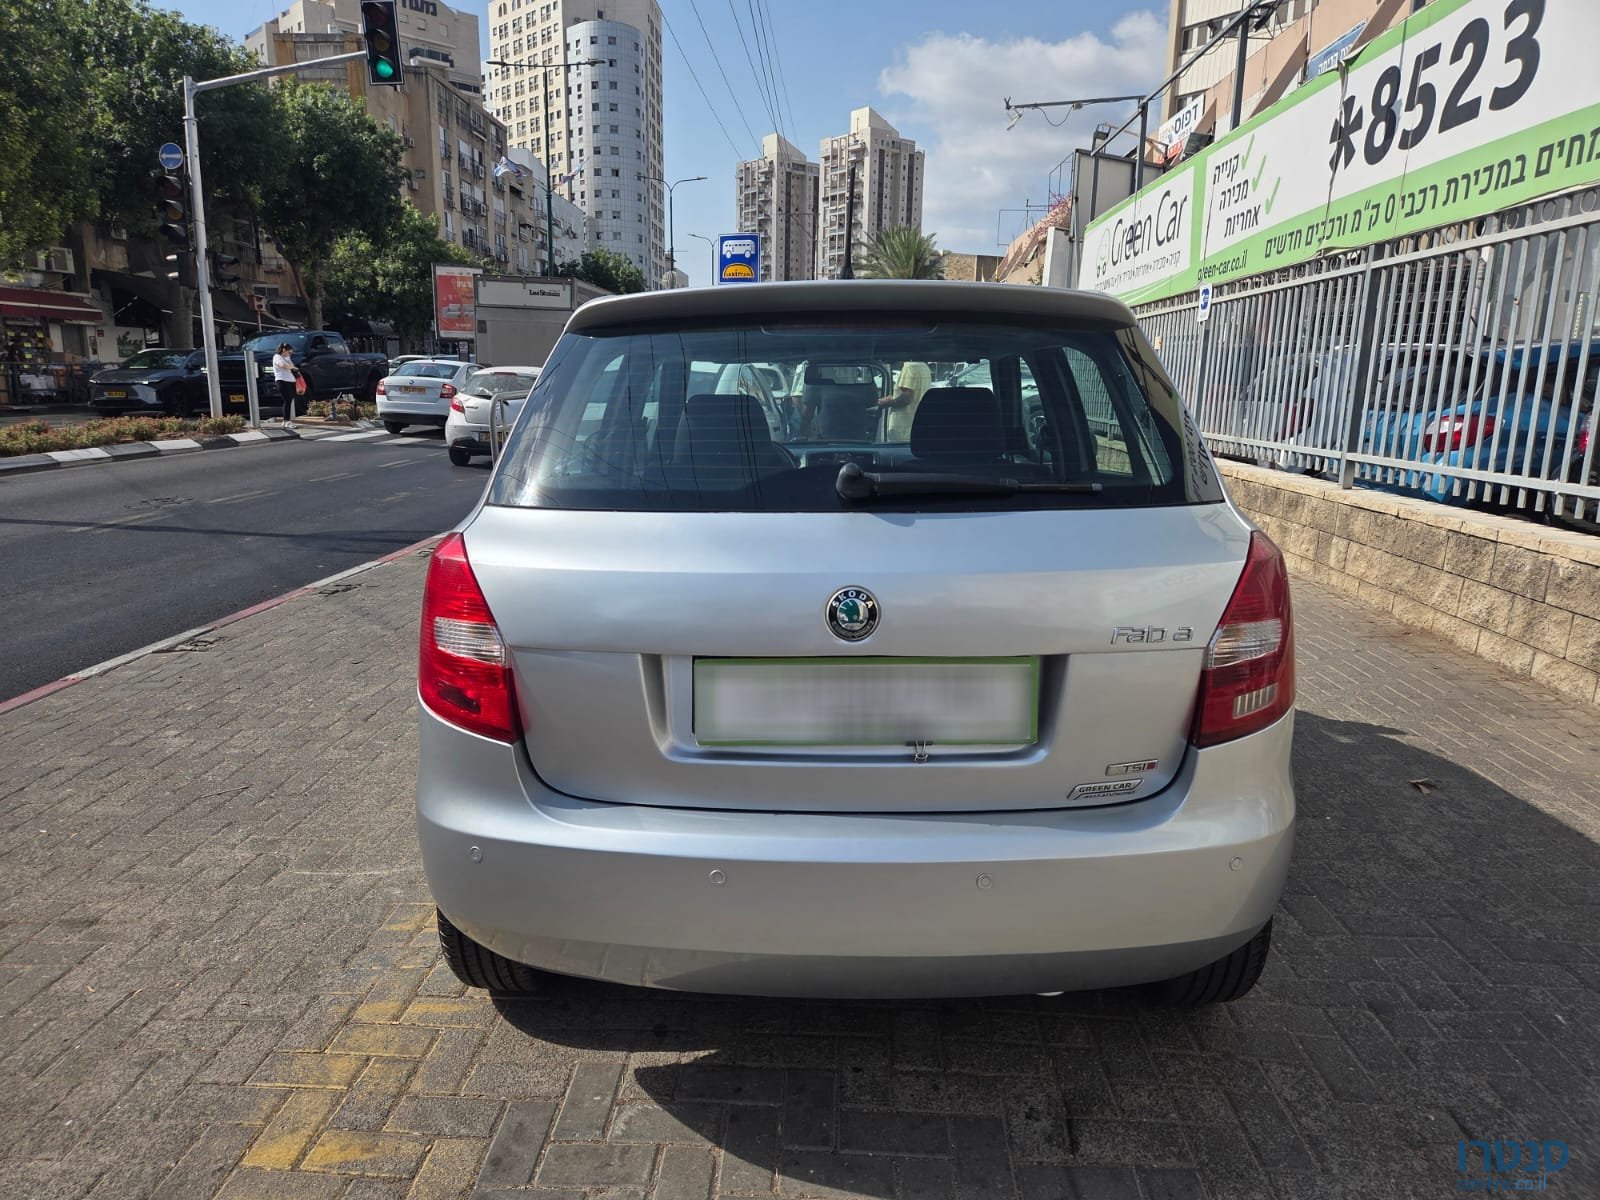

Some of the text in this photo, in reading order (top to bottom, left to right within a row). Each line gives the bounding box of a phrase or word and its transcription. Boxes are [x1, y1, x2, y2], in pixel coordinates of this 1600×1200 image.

[1175, 104, 1198, 134] דפוס
[1213, 154, 1239, 185] קנייה
[1442, 154, 1526, 206] במכירת
[1219, 179, 1249, 211] מכירה
[1385, 194, 1396, 223] 0
[1401, 184, 1438, 217] רכבי
[1111, 190, 1187, 266] Green Car
[1224, 204, 1261, 238] אחריות
[1305, 213, 1348, 246] ורכבים
[1265, 229, 1303, 258] חדשים
[1122, 763, 1146, 773] TSI
[1078, 782, 1132, 793] GREEN CAR
